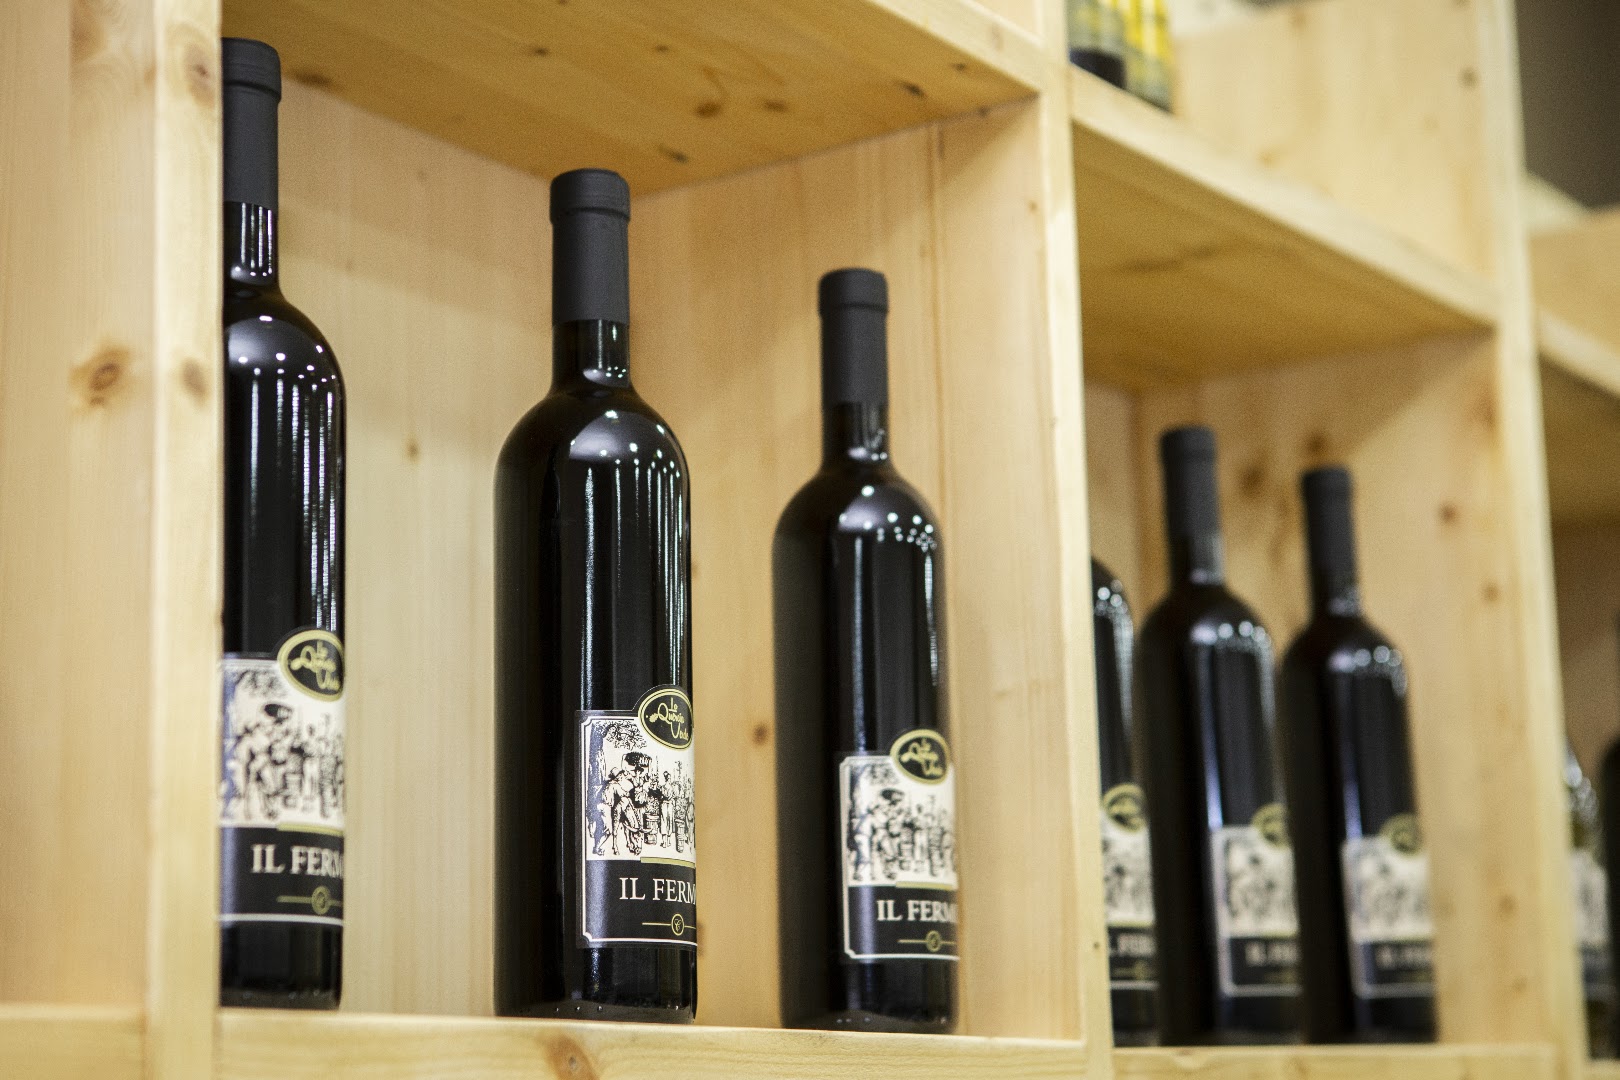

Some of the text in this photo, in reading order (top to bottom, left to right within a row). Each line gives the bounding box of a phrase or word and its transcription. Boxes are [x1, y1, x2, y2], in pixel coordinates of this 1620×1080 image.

[250, 843, 286, 874] IL
[619, 877, 646, 900] IL
[876, 900, 903, 921] IL
